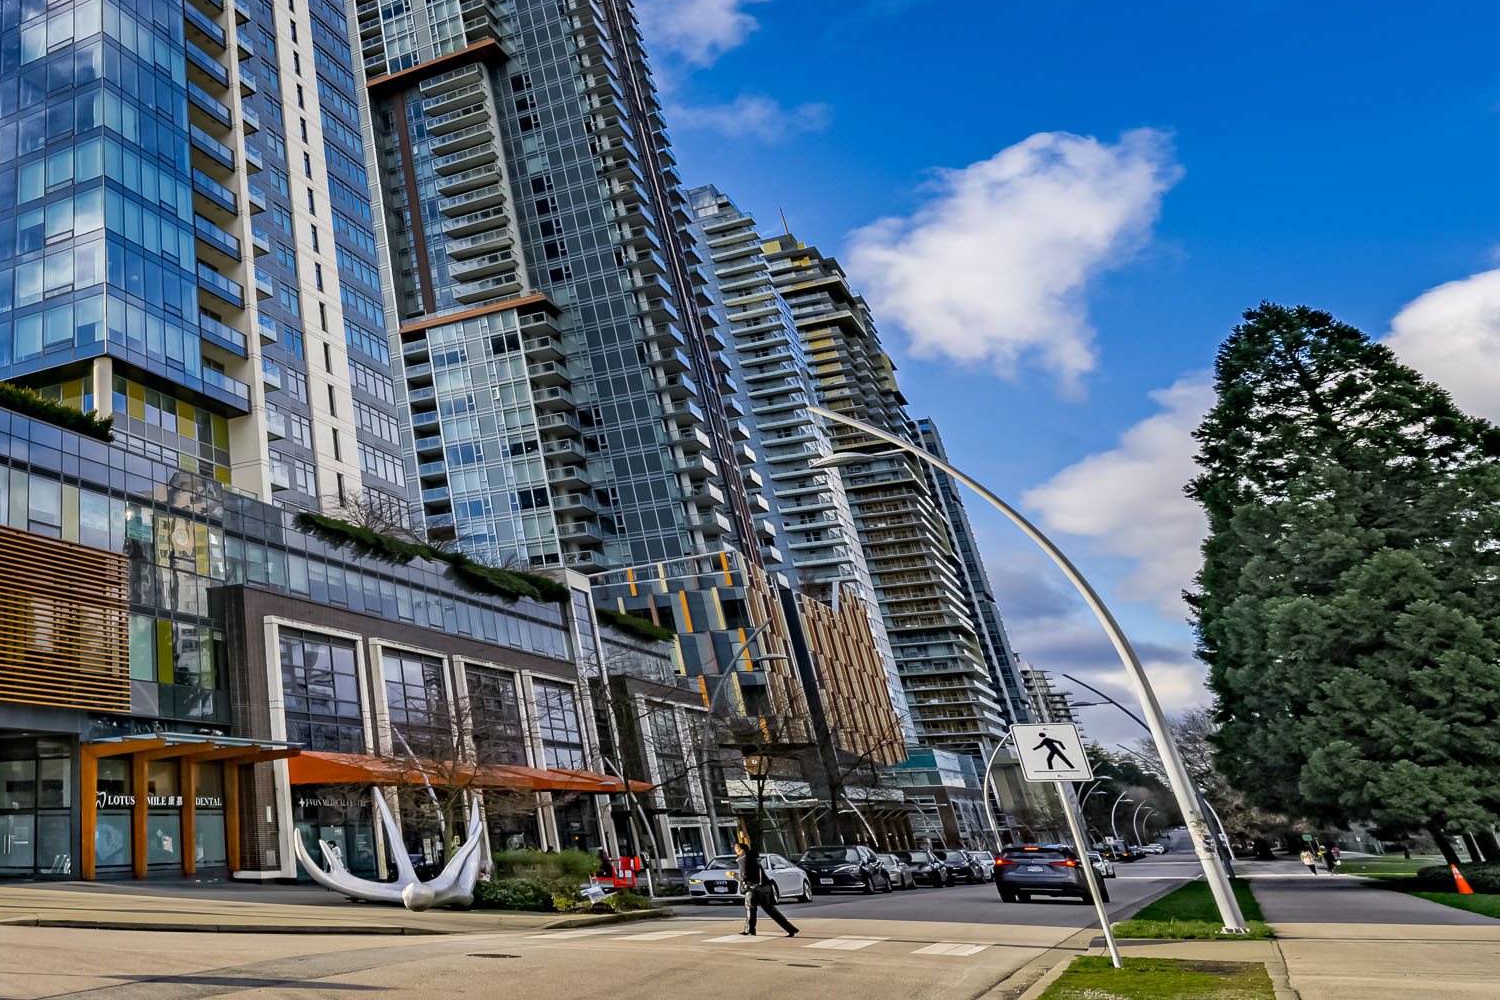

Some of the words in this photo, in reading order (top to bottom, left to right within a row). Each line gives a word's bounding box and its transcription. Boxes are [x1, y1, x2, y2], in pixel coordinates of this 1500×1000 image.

[108, 795, 136, 806] LOTUS
[146, 796, 167, 806] MILE
[195, 797, 222, 806] DENTAL
